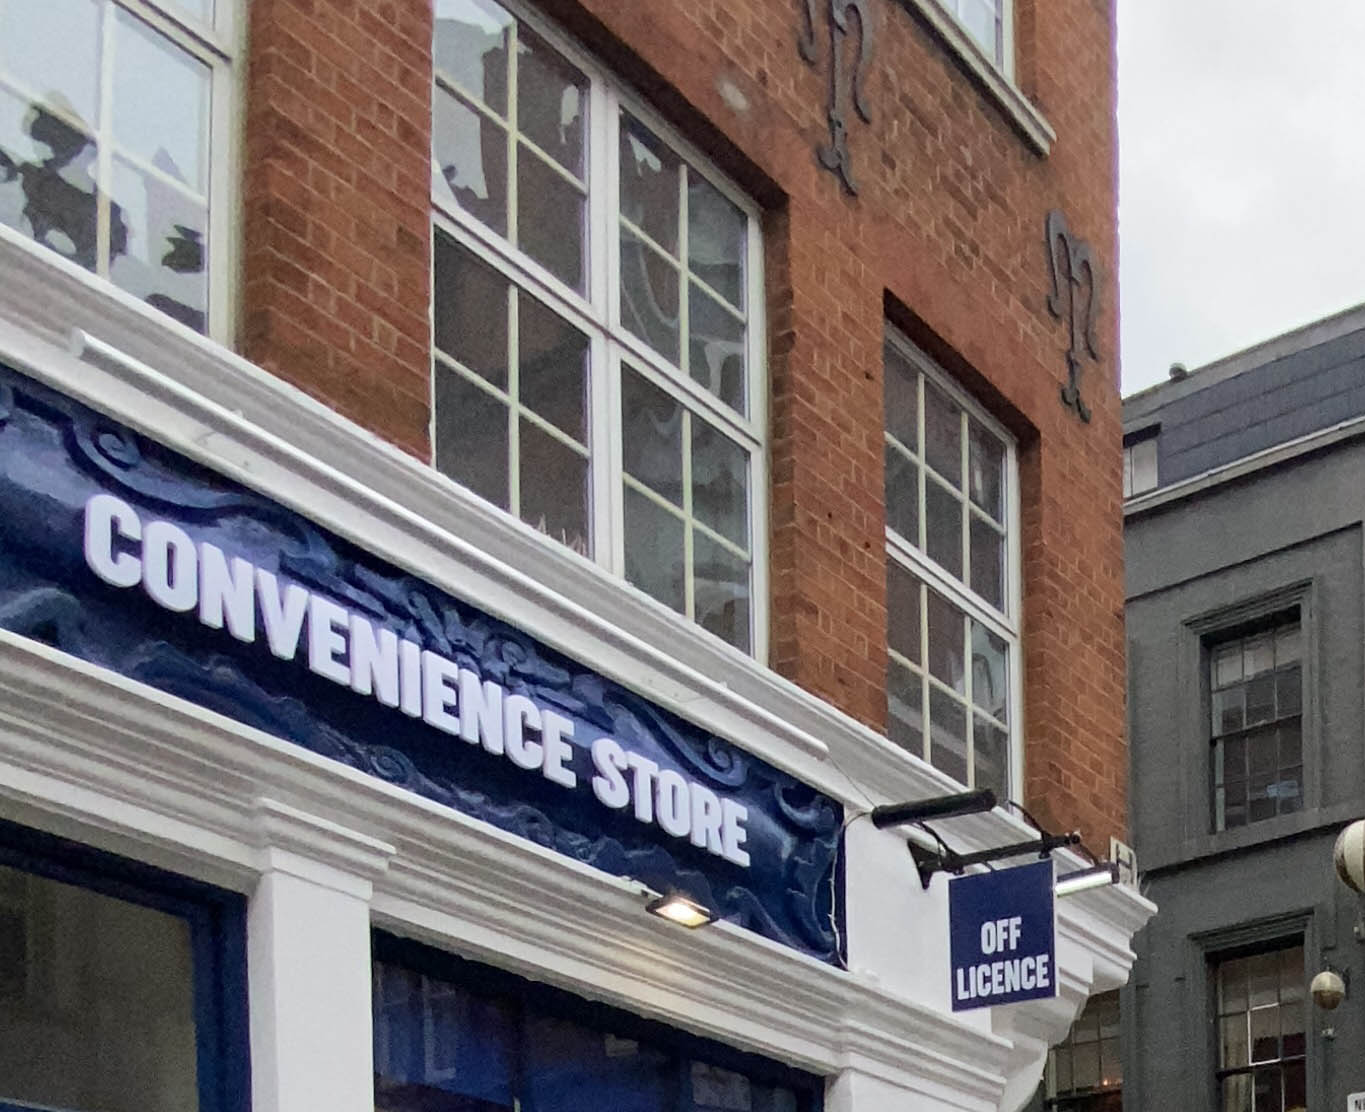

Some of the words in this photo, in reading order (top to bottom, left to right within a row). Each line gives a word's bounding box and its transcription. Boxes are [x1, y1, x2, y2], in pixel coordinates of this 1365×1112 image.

[84, 494, 577, 790] CONVENIENCE
[591, 736, 752, 868] STORE
[980, 916, 1022, 955] OFF
[956, 953, 1050, 1001] LICENCE
